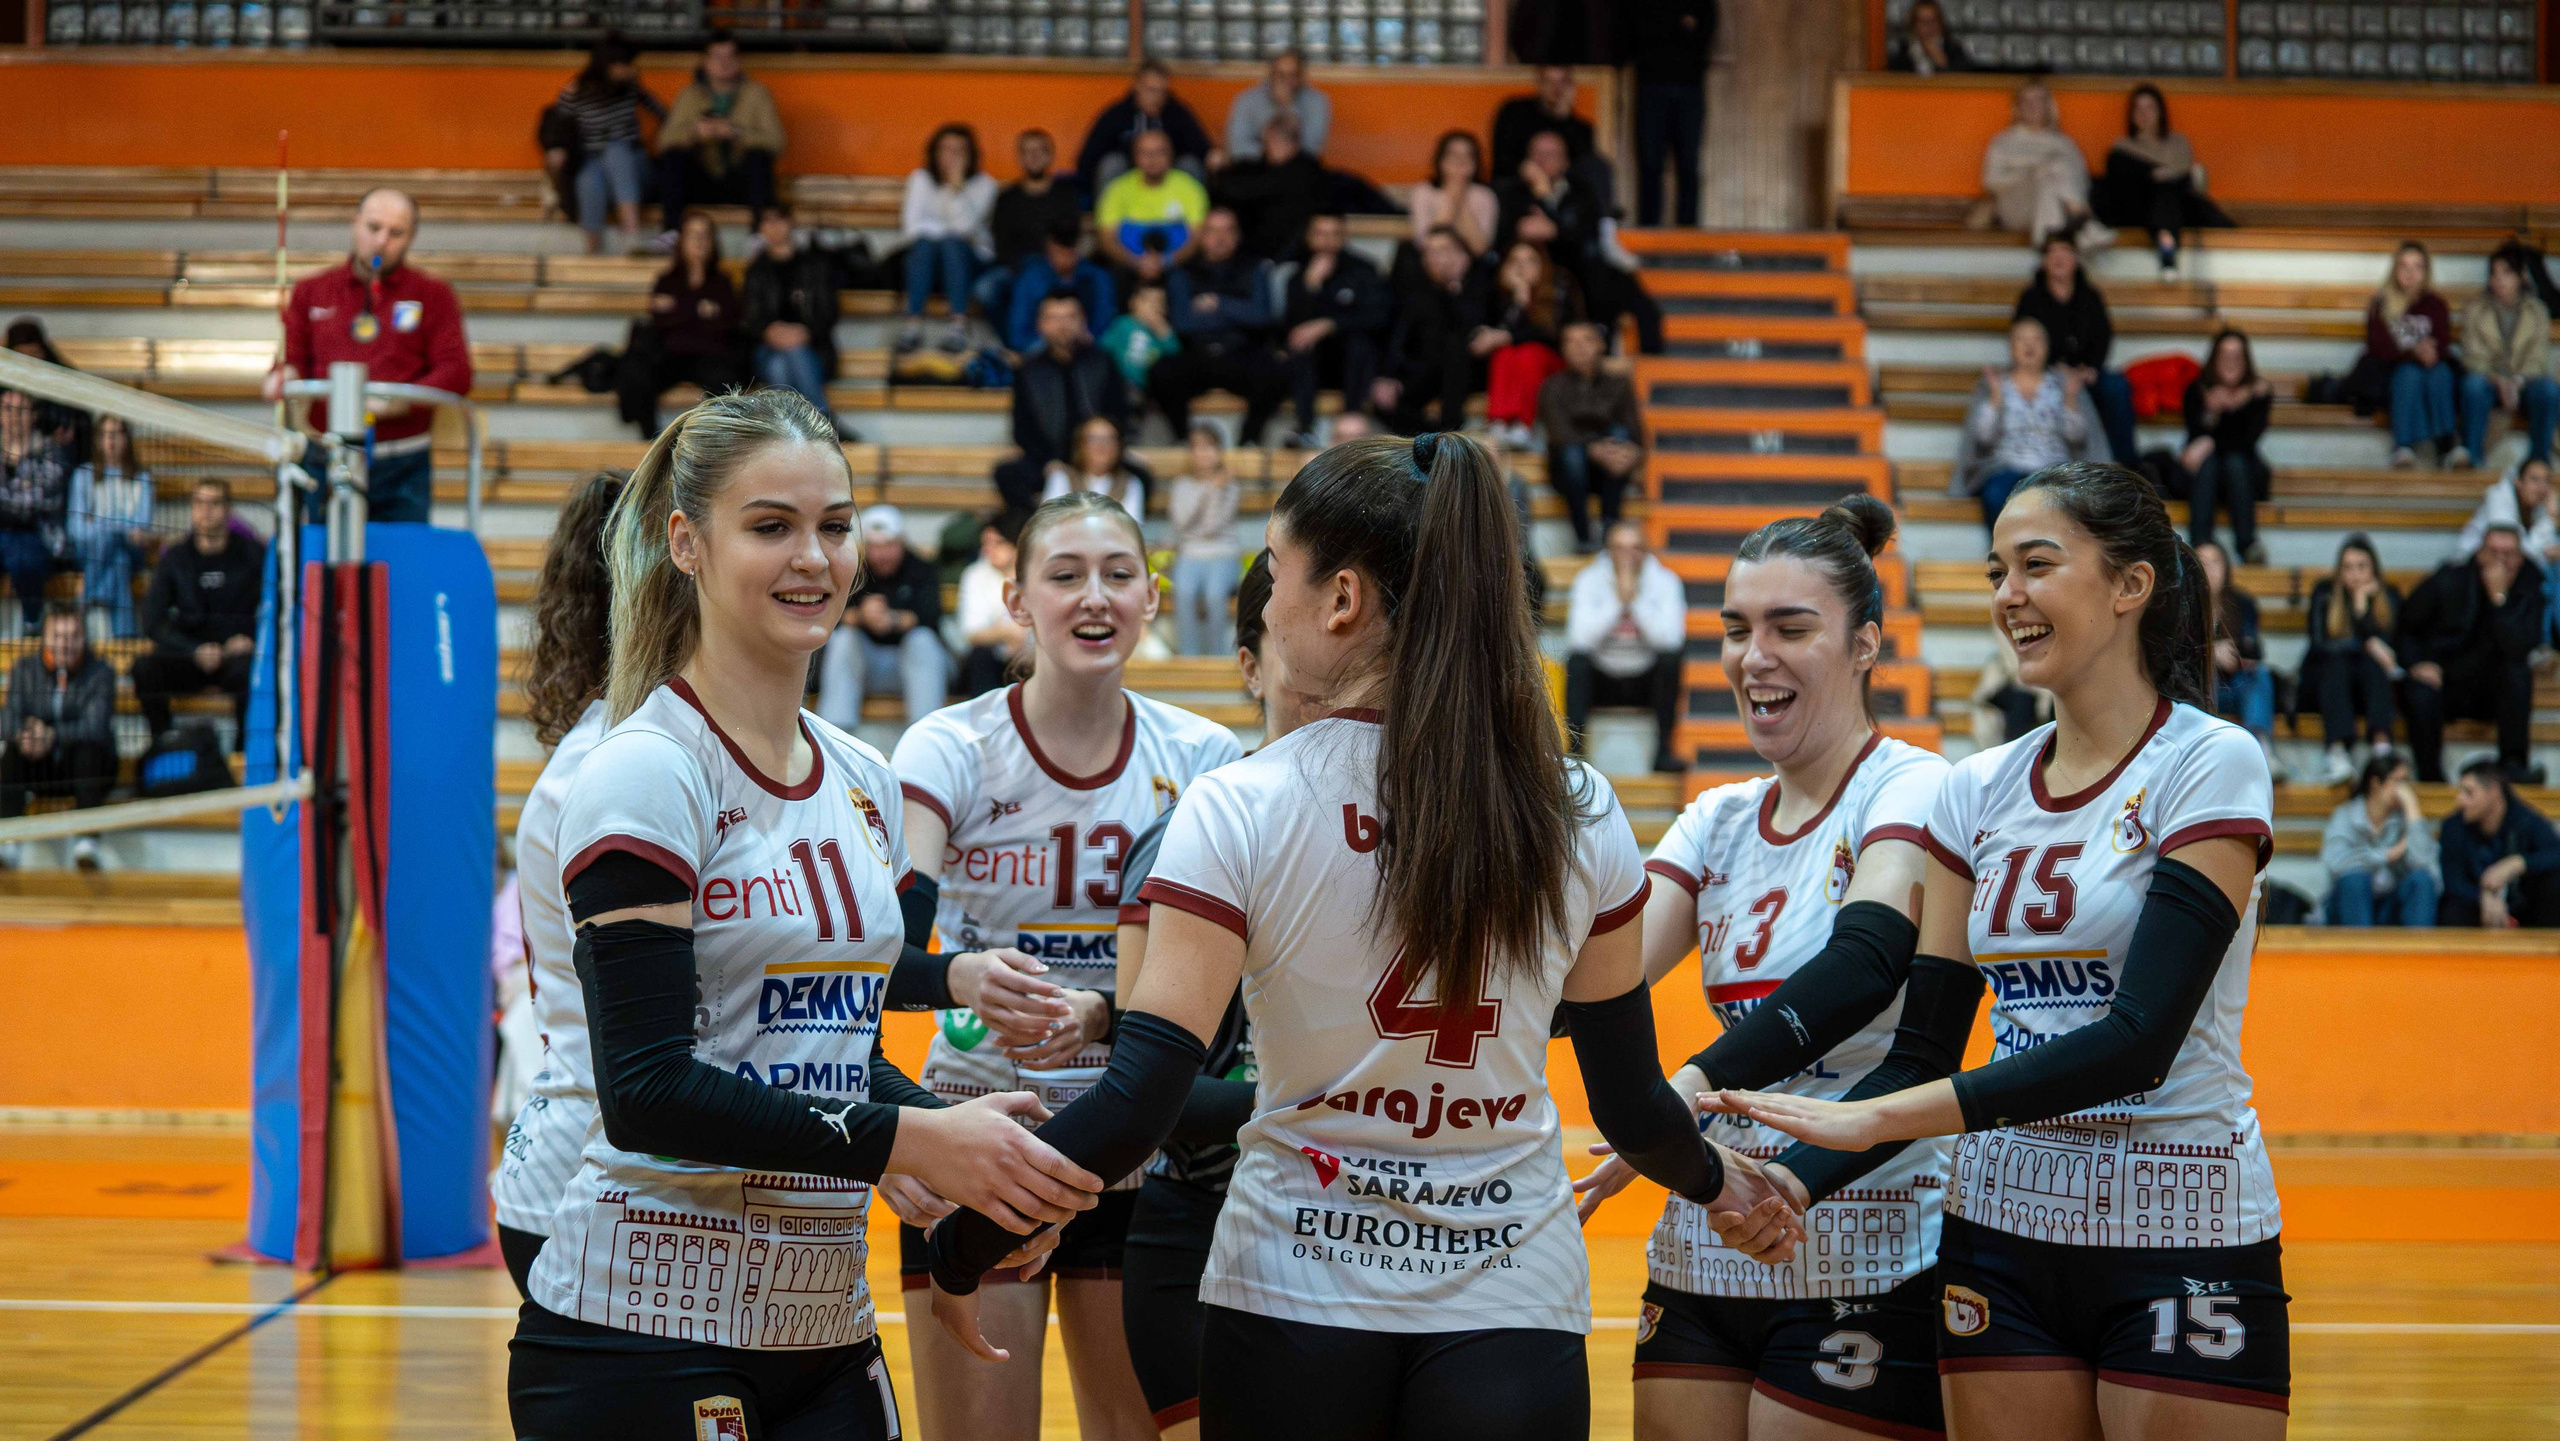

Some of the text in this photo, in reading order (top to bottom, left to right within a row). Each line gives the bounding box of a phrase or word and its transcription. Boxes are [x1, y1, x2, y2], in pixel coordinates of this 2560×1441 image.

[788, 838, 865, 942] 11
[1050, 820, 1137, 909] 13
[1988, 840, 2087, 937] 15
[697, 868, 803, 921] enti
[1698, 913, 1733, 954] nti
[1733, 886, 1789, 972] 3
[757, 975, 885, 1025] DEMUS
[1366, 897, 1502, 1070] 4
[1342, 1156, 1427, 1177] VISIT
[1346, 1174, 1513, 1207] SARAJEVO
[1294, 1207, 1524, 1254] EUROHERC
[1292, 1243, 1522, 1275] OSIGURANJE d.d.
[2149, 1295, 2246, 1361] 15
[1811, 1329, 1884, 1390] 3
[698, 1405, 741, 1418] bosna
